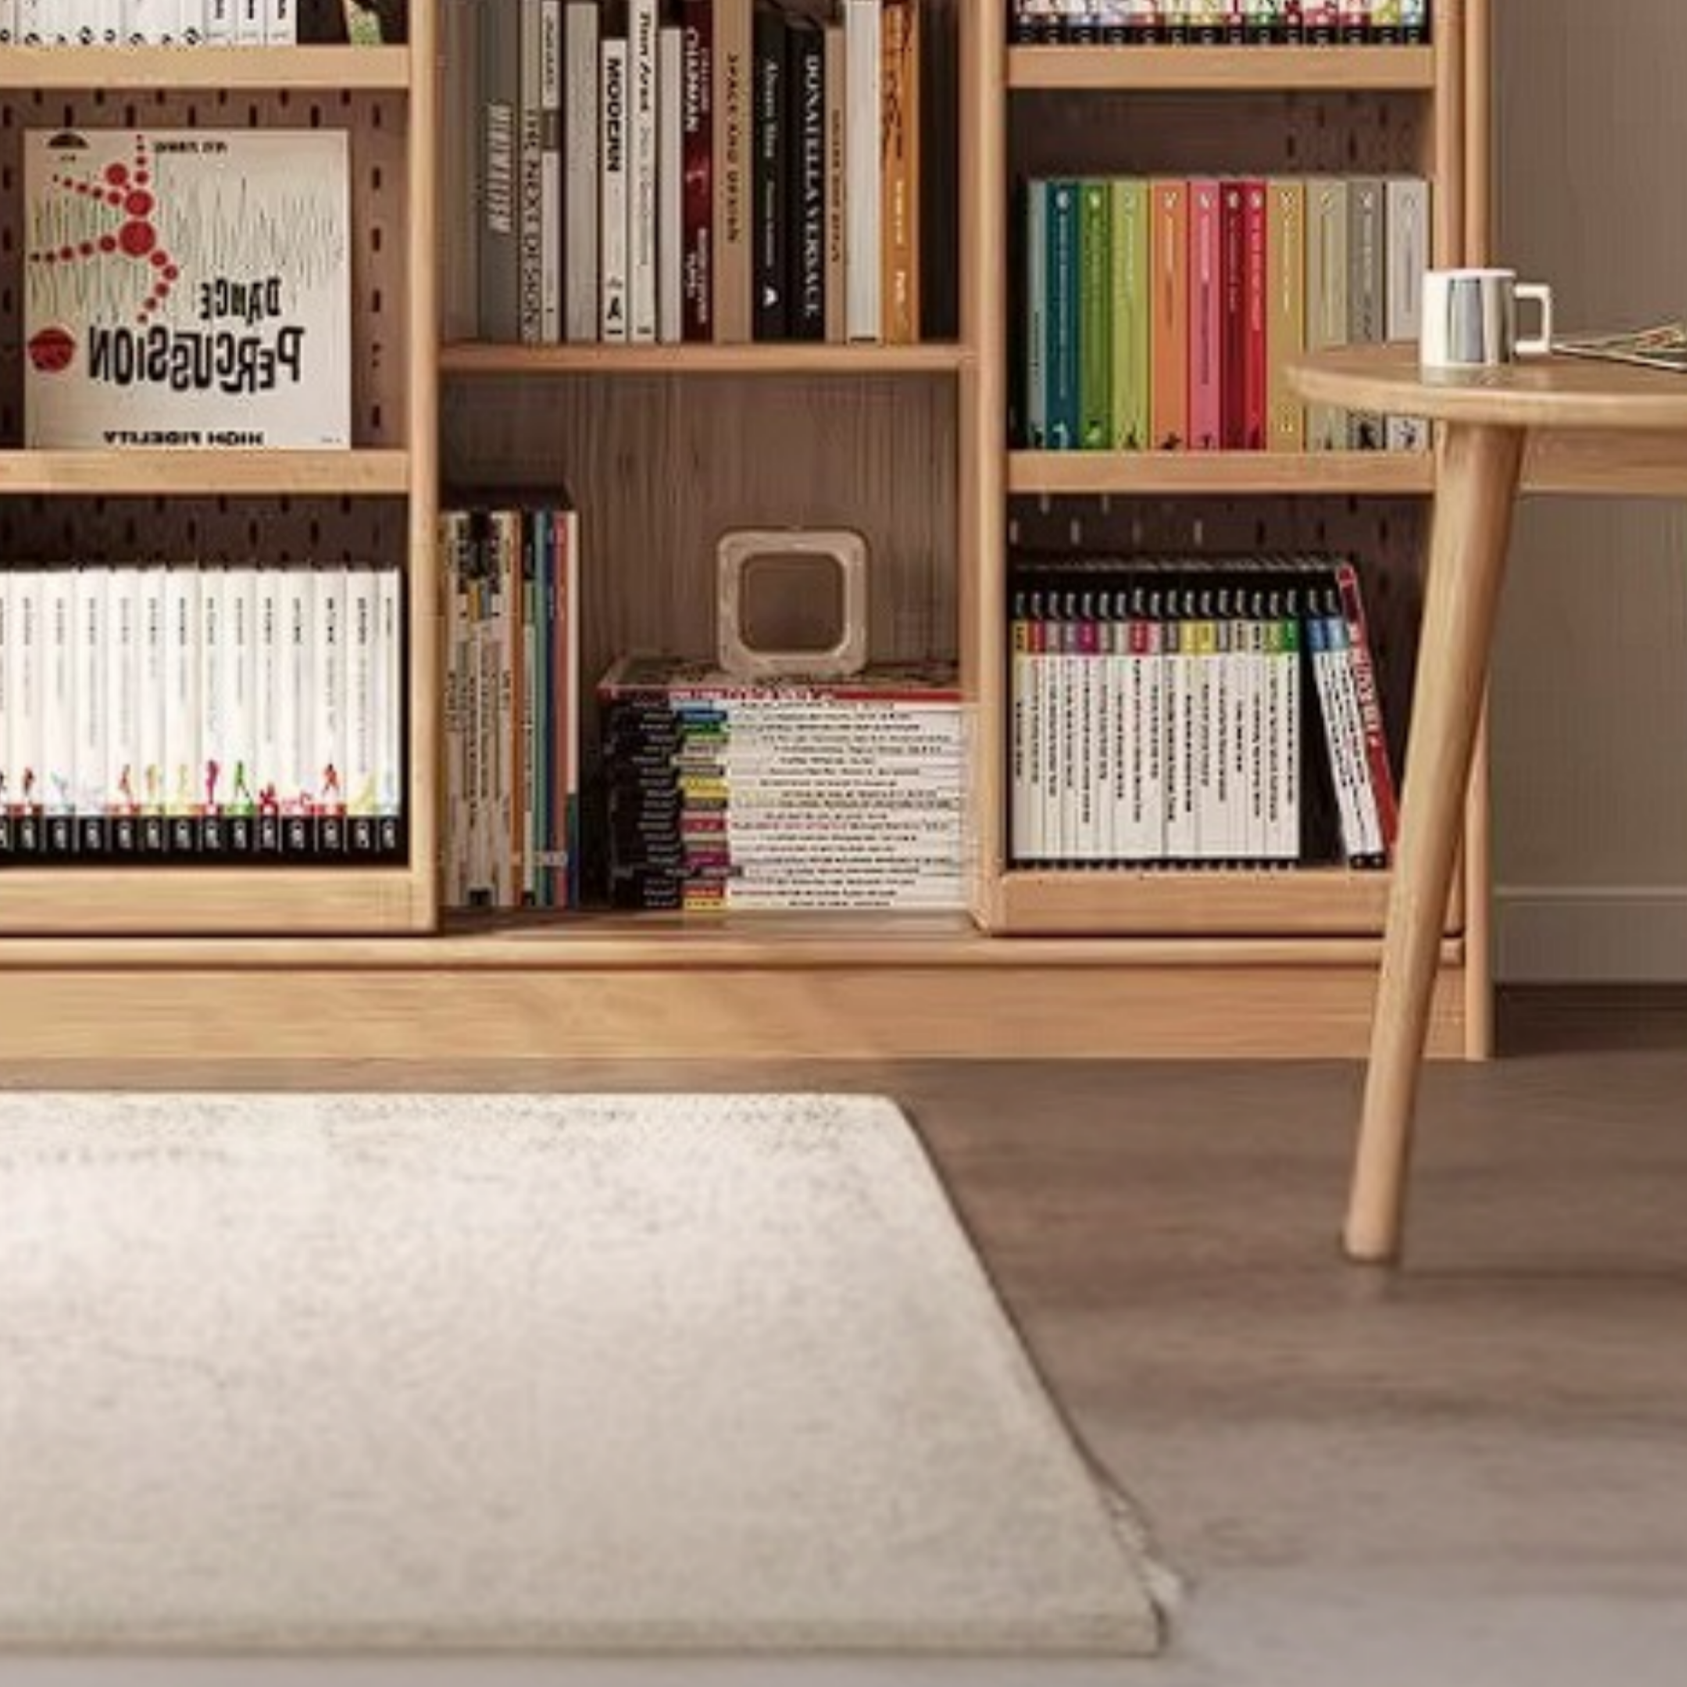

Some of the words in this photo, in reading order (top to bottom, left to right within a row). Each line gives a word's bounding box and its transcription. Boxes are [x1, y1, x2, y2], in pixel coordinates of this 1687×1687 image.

[607, 58, 621, 171] MODERN
[727, 53, 739, 116] SPACE
[805, 54, 820, 201] DONATELLA
[523, 160, 539, 225] NEXT
[727, 170, 739, 244] DESIGN
[523, 233, 539, 325] DESIGN
[805, 204, 820, 318] VERSACE
